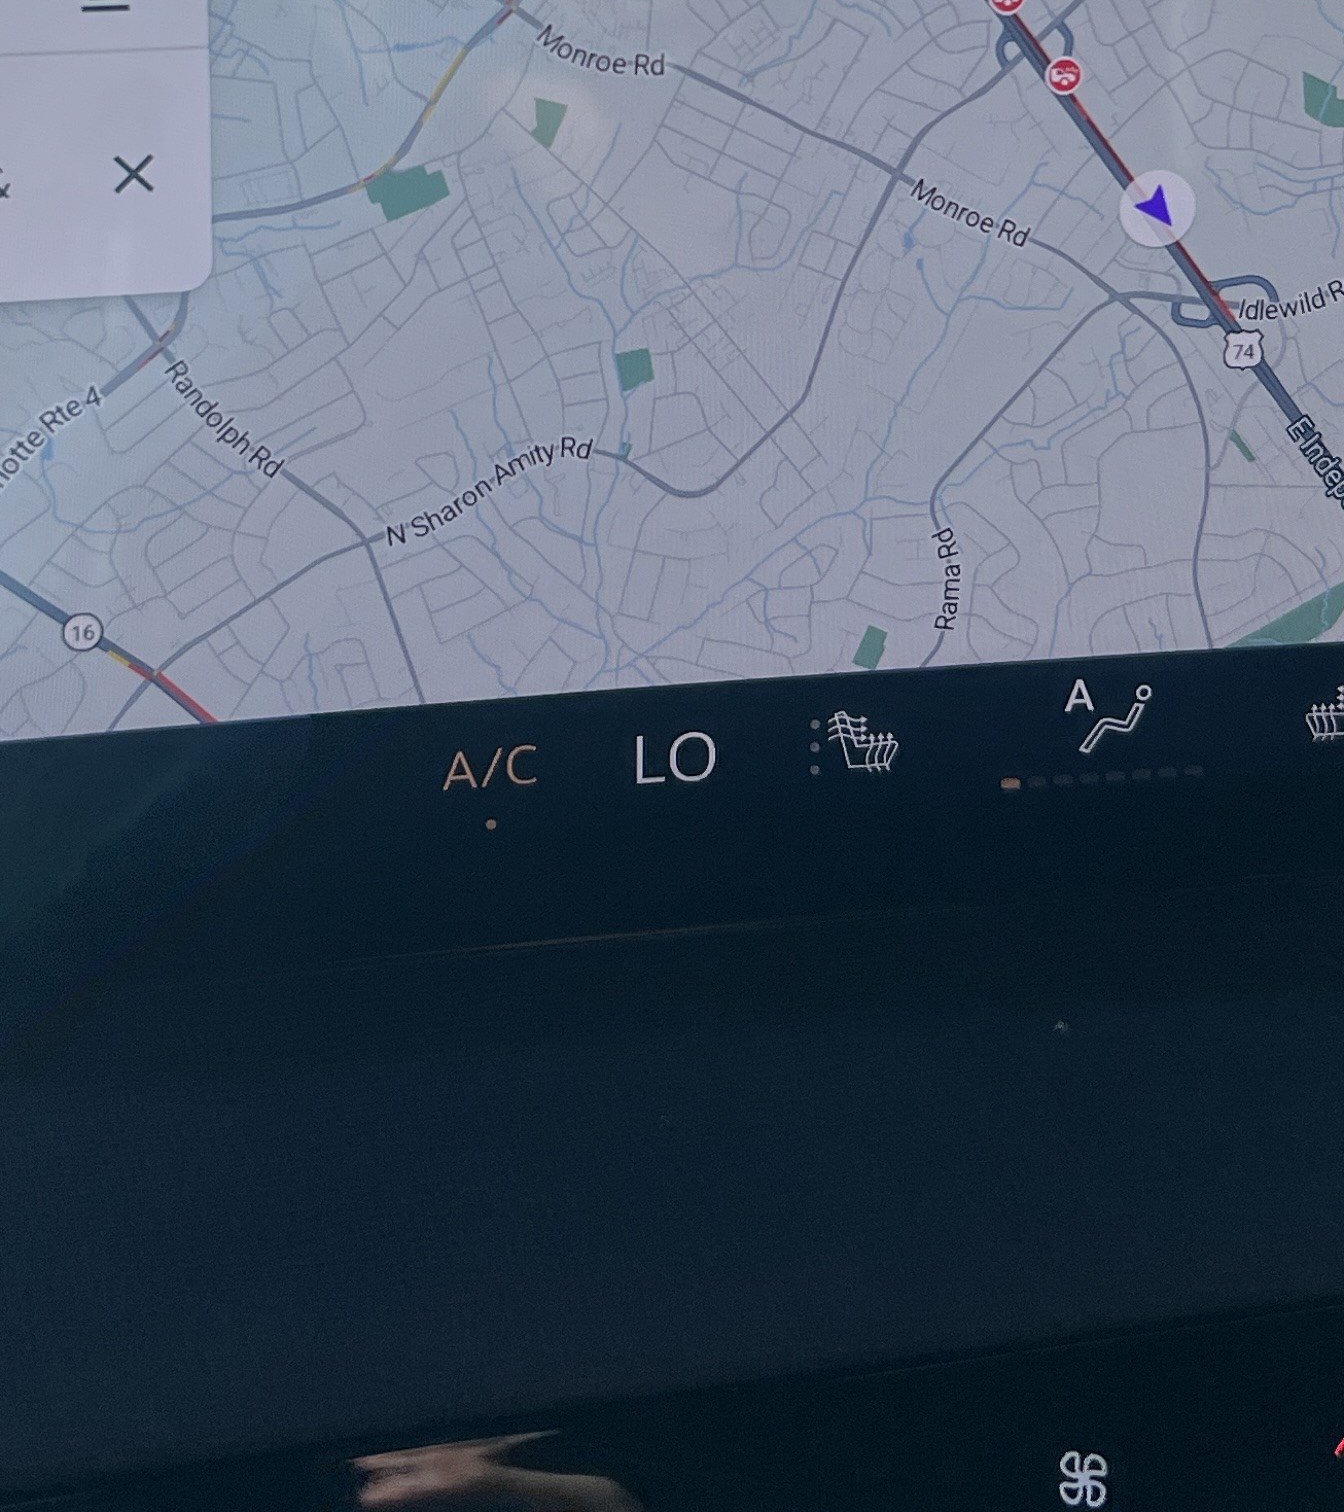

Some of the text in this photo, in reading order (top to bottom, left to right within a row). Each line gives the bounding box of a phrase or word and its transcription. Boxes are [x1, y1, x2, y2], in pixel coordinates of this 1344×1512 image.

[536, 24, 666, 78] Monroe Rd
[910, 178, 1031, 248] Monroe Rd
[1238, 290, 1327, 323] Idlewild
[1231, 341, 1256, 362] 74
[37, 397, 85, 437] Rte
[83, 385, 104, 409] 4
[164, 359, 286, 480] Randolph Rd
[1288, 417, 1314, 444] E
[385, 436, 595, 548] N Sharon Amity Rd
[932, 528, 962, 632] Rama Rd
[71, 623, 95, 643] 16
[1064, 678, 1096, 715] A
[441, 743, 540, 793] A/C
[634, 730, 718, 786] LO
